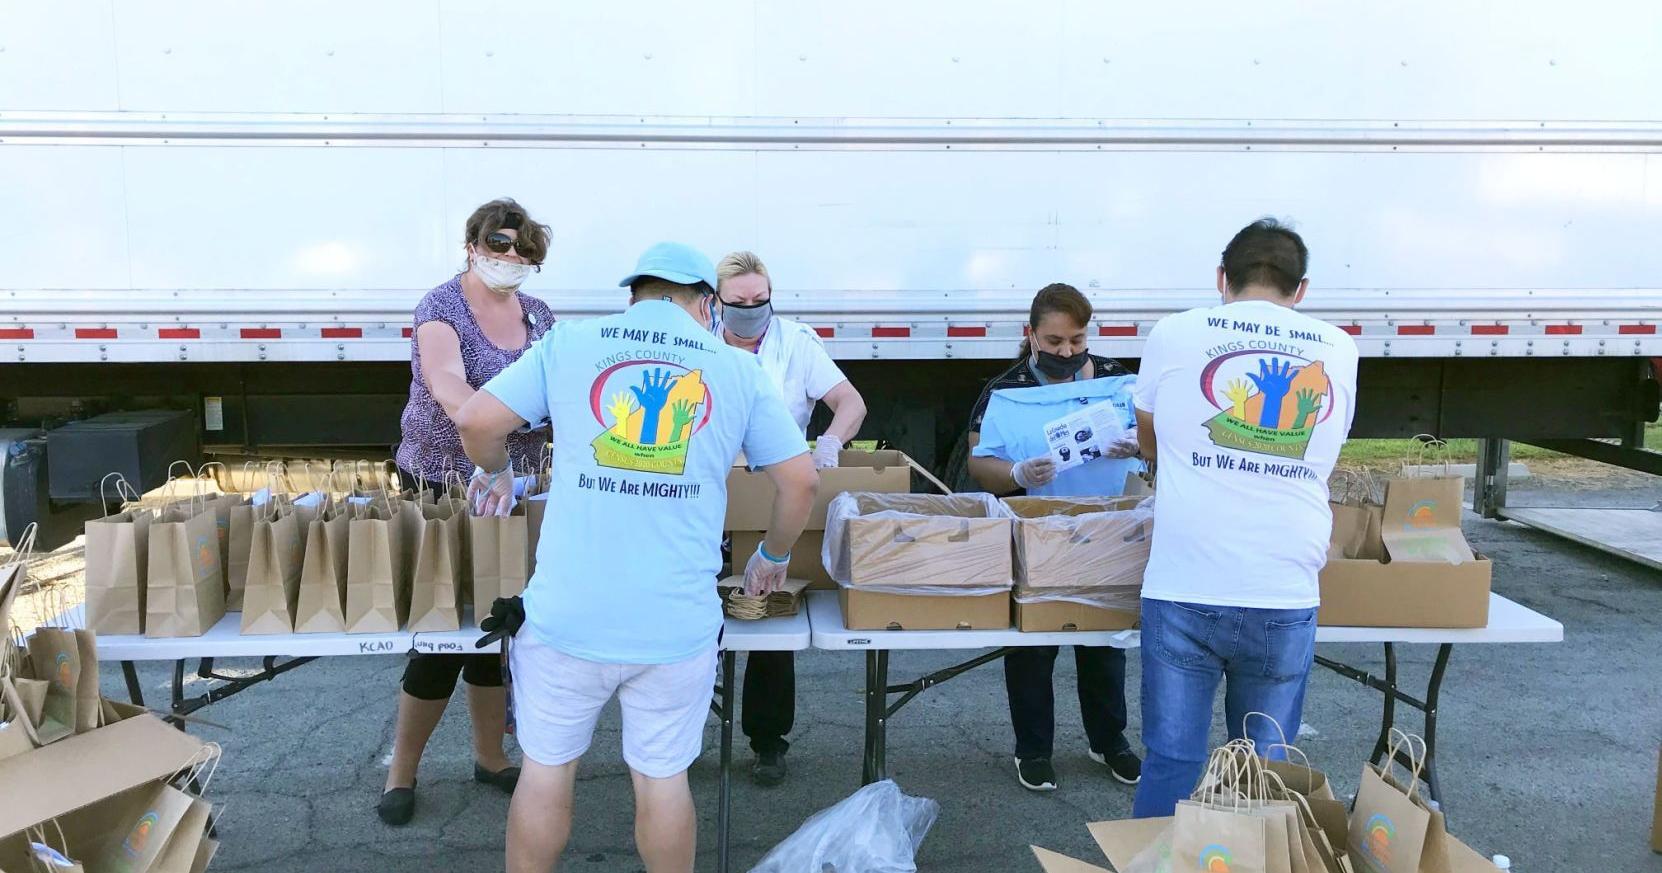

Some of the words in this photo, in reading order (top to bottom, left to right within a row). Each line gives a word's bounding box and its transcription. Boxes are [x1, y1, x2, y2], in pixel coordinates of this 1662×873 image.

[600, 327, 620, 339] WE
[622, 328, 649, 343] MAY
[652, 332, 667, 345] BE
[1207, 317, 1229, 329] WE
[1232, 320, 1261, 334] MAY
[1265, 325, 1281, 337] BE
[1205, 341, 1245, 359] KINGS
[1248, 340, 1305, 356] COUNTY
[594, 350, 632, 373] KINGS
[635, 349, 686, 365] COUNTY
[1227, 417, 1239, 425] WE
[1240, 423, 1255, 432] ALL
[1256, 427, 1278, 436] HAVE
[610, 435, 621, 443] WE
[622, 441, 635, 450] ALL
[636, 444, 657, 453] HAVE
[658, 443, 682, 452] VALUE
[1254, 434, 1275, 442] when
[642, 482, 701, 499] MIGHTY!!!
